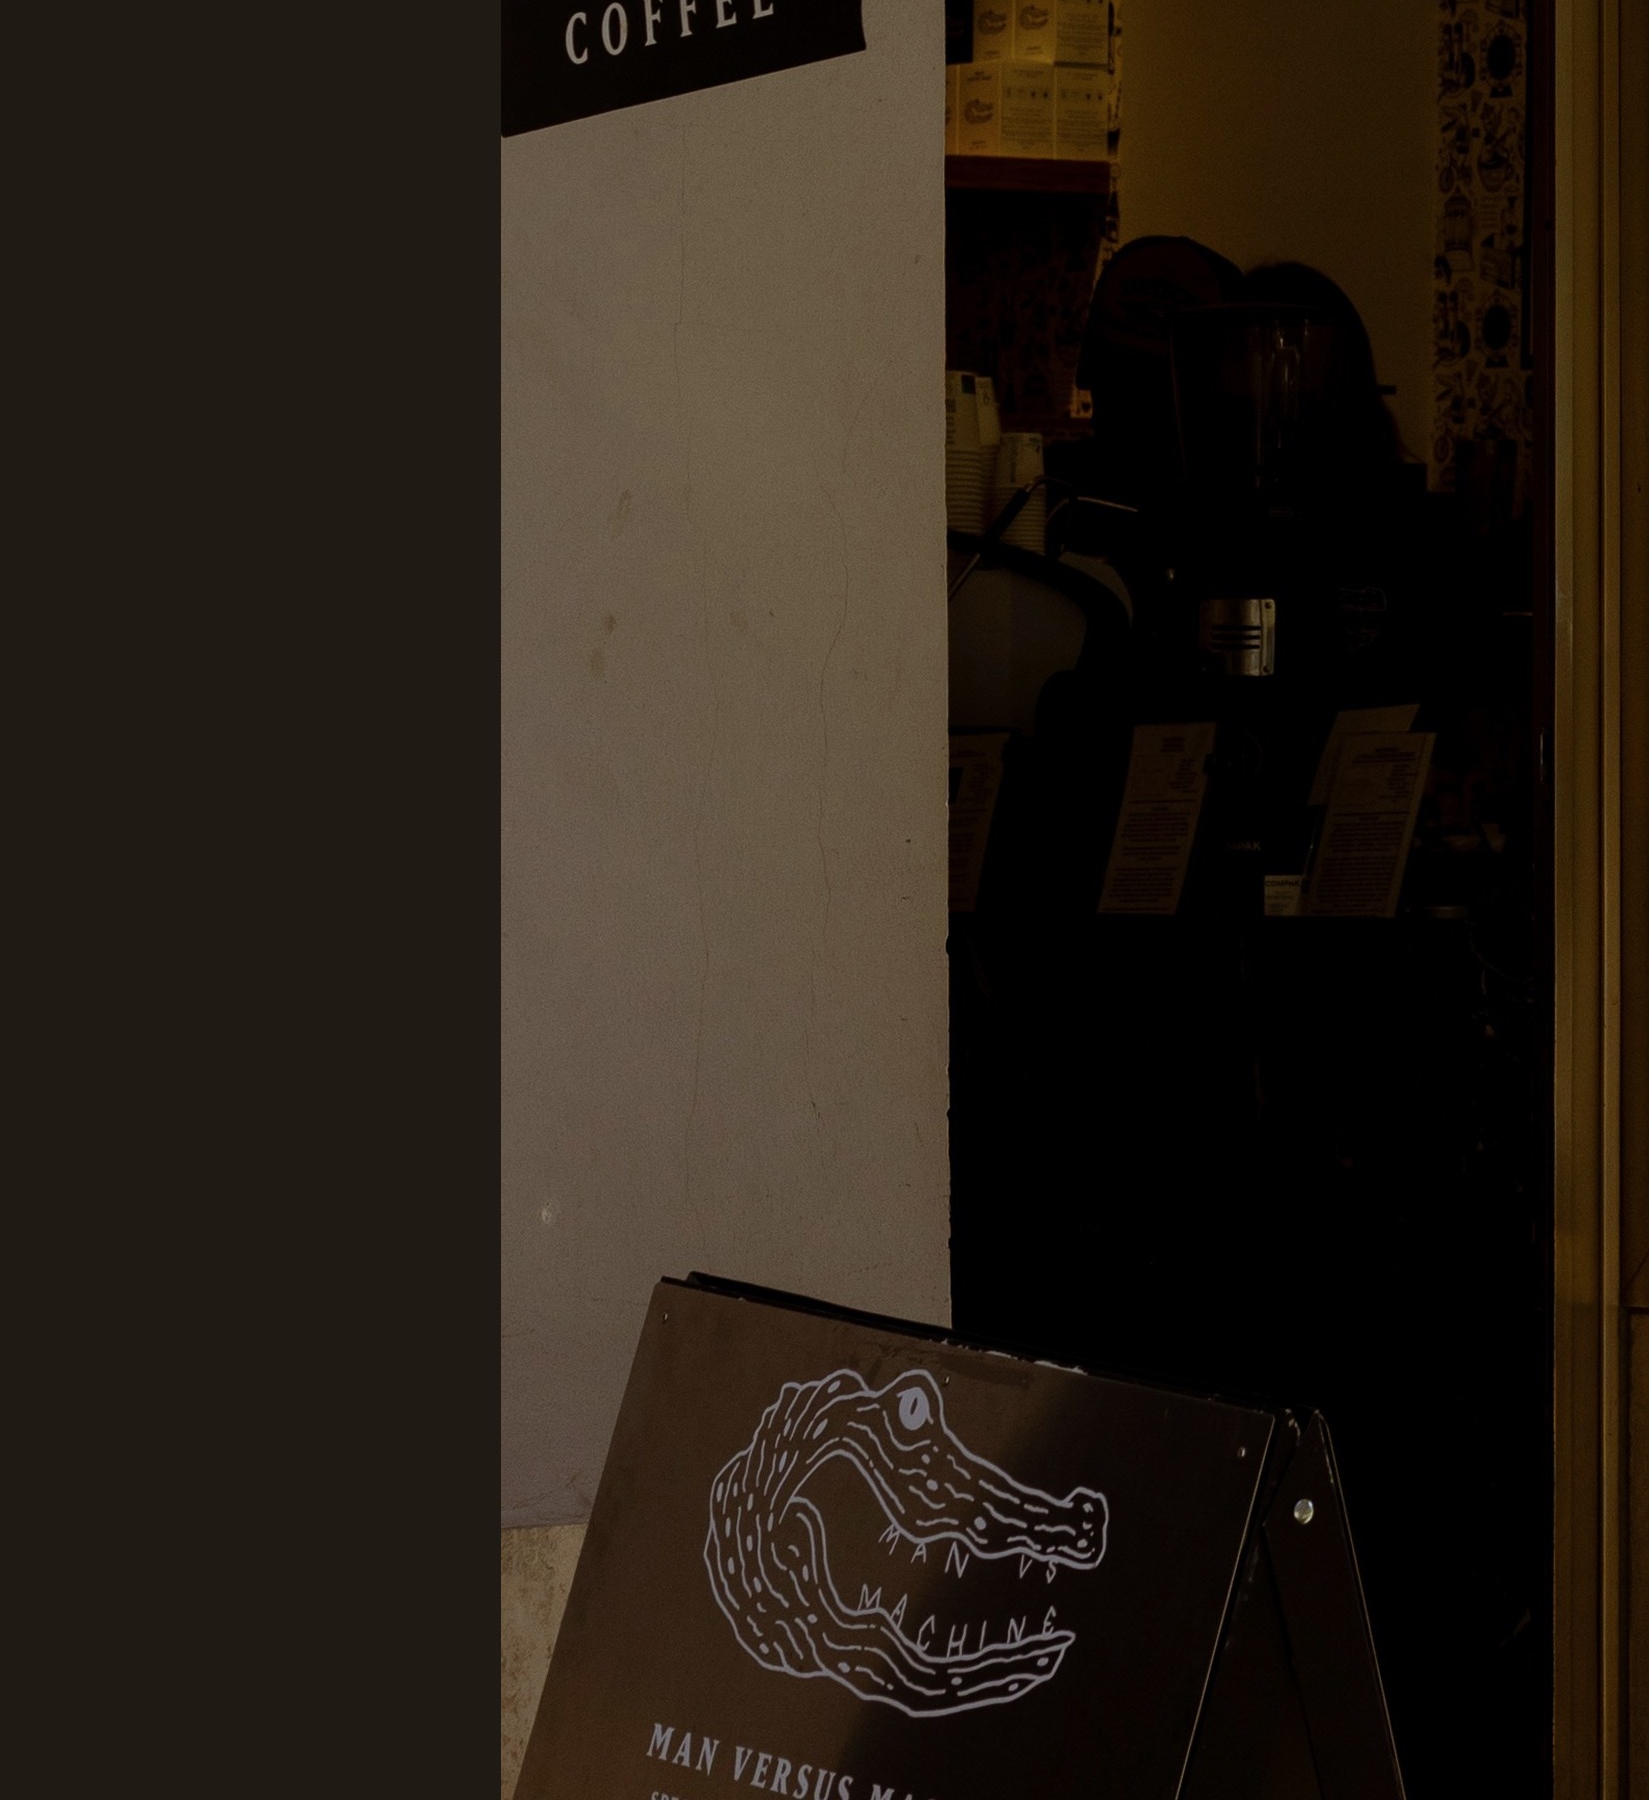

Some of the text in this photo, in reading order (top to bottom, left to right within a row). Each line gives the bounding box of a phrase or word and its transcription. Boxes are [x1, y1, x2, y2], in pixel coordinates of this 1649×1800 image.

[878, 1524, 970, 1579] MAN
[857, 1582, 1058, 1658] MACHINE
[646, 1722, 854, 1800] MAN VERSUS
